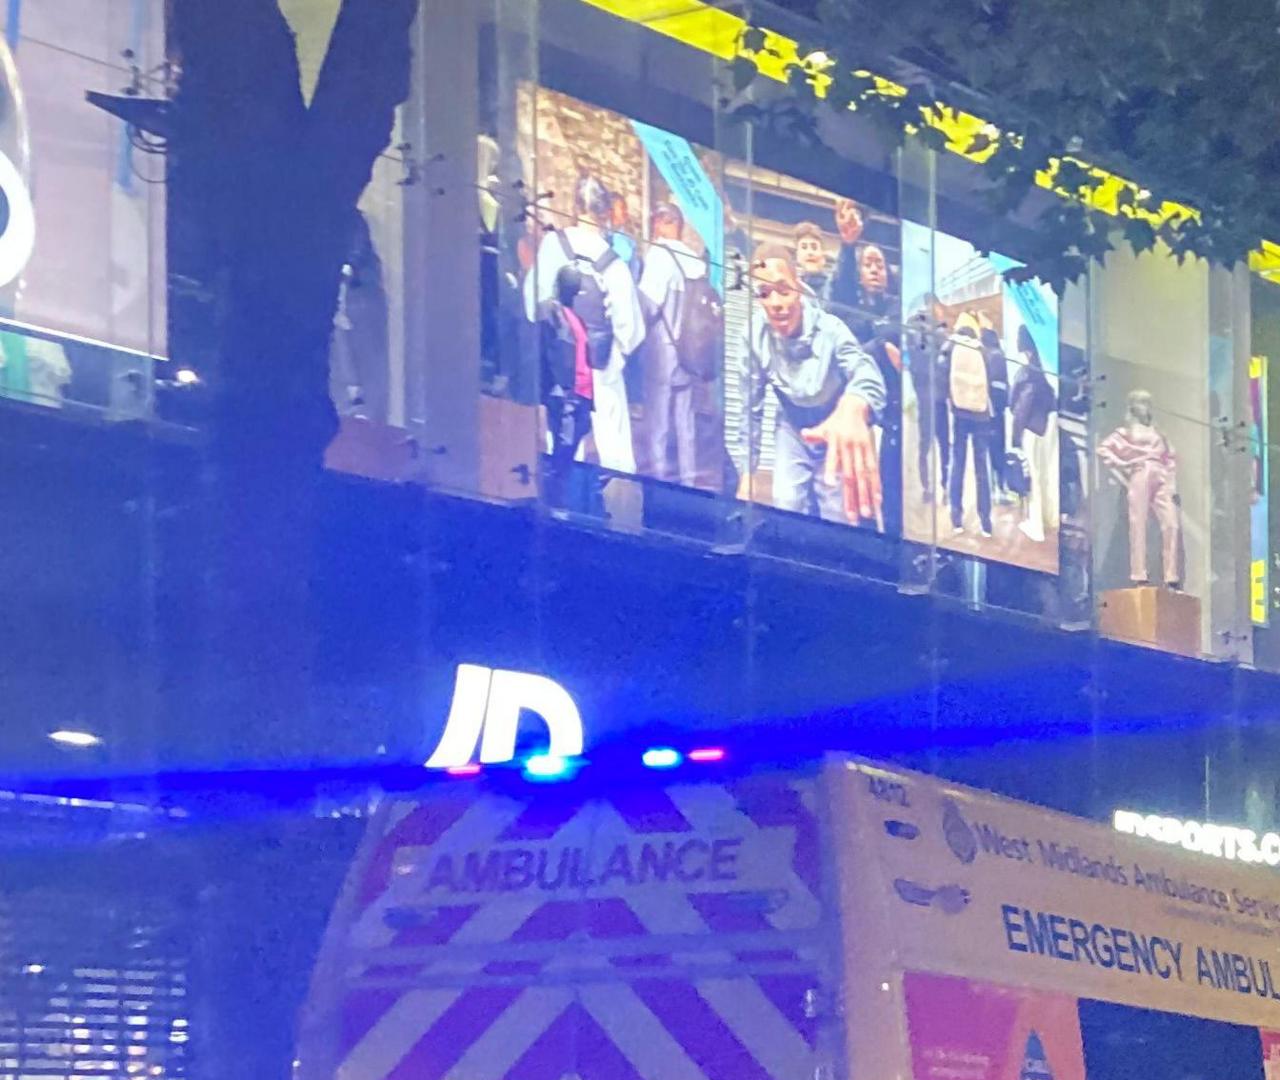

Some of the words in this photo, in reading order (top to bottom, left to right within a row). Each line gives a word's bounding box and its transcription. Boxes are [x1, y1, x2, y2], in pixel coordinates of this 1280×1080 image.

[423, 663, 584, 768] JD
[424, 837, 746, 894] AMBULANCE
[974, 822, 1033, 864] West
[1038, 839, 1129, 886] Midlands
[1135, 863, 1230, 912] Ambulance
[1001, 903, 1183, 983] EMERGENCY
